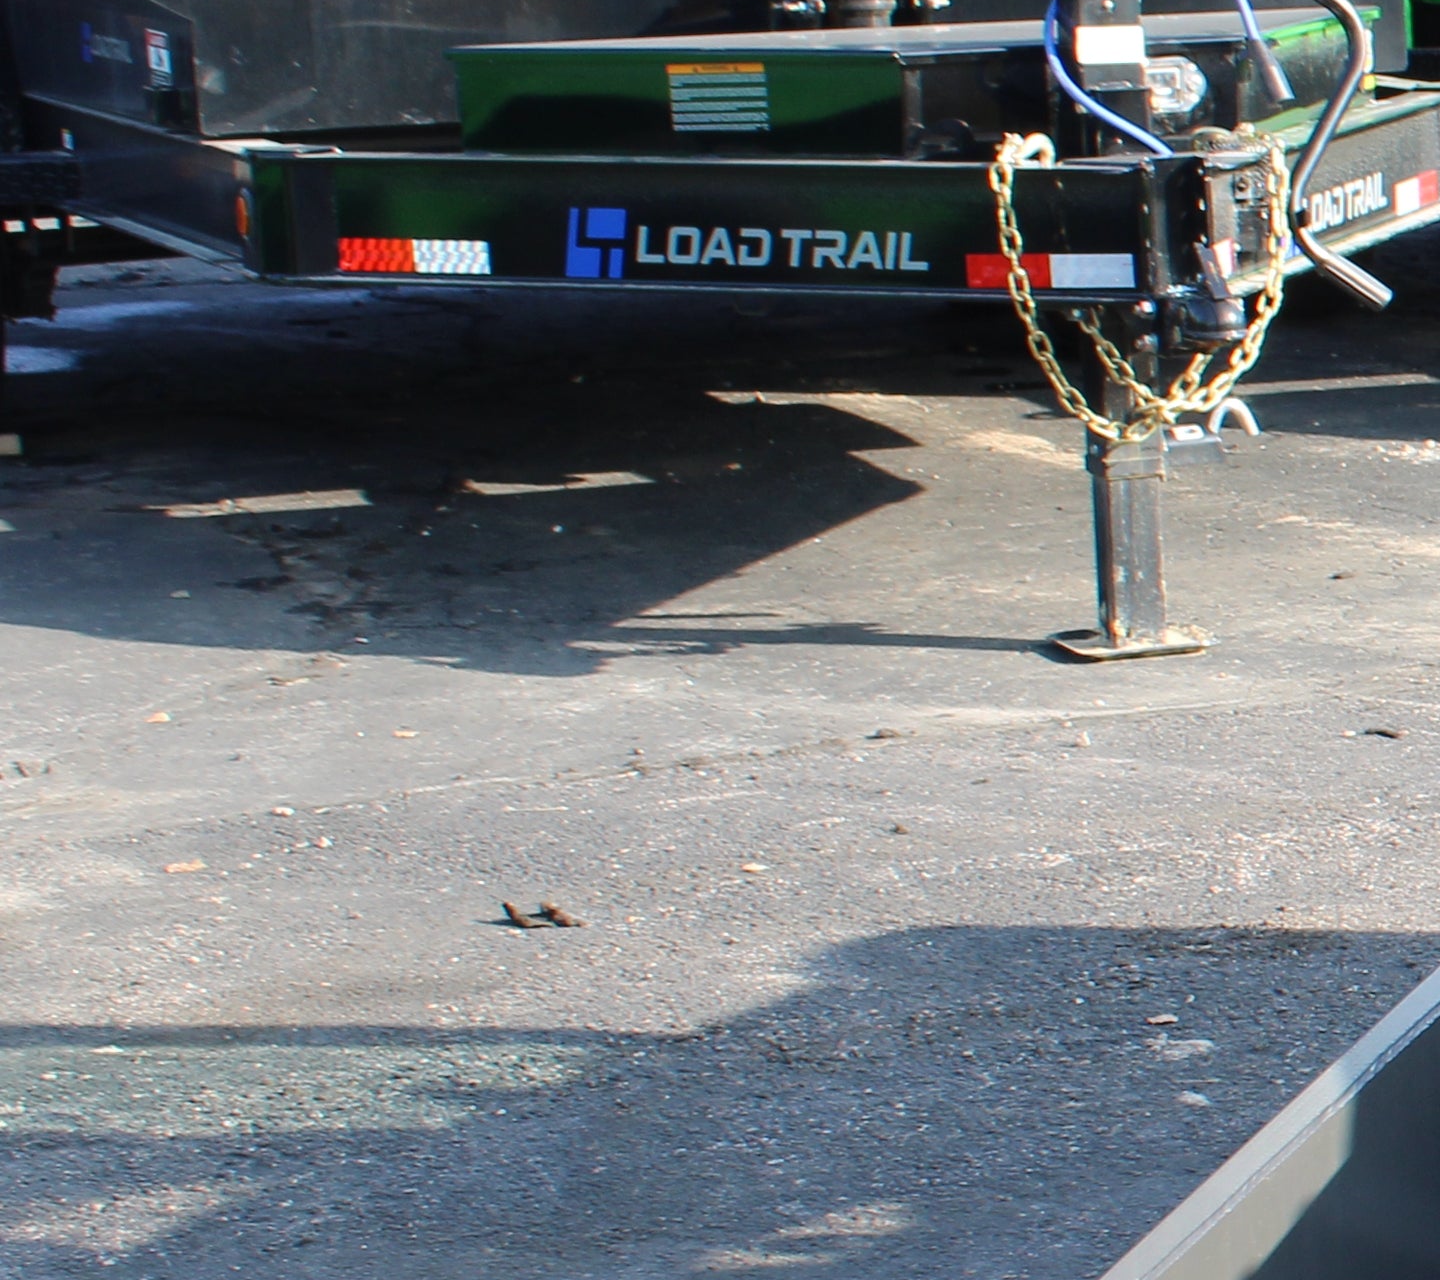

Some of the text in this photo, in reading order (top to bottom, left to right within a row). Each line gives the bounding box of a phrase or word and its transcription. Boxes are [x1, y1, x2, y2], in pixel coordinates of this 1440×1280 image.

[1343, 171, 1389, 221] TRAIL
[635, 223, 931, 272] LOAD TRAIL
